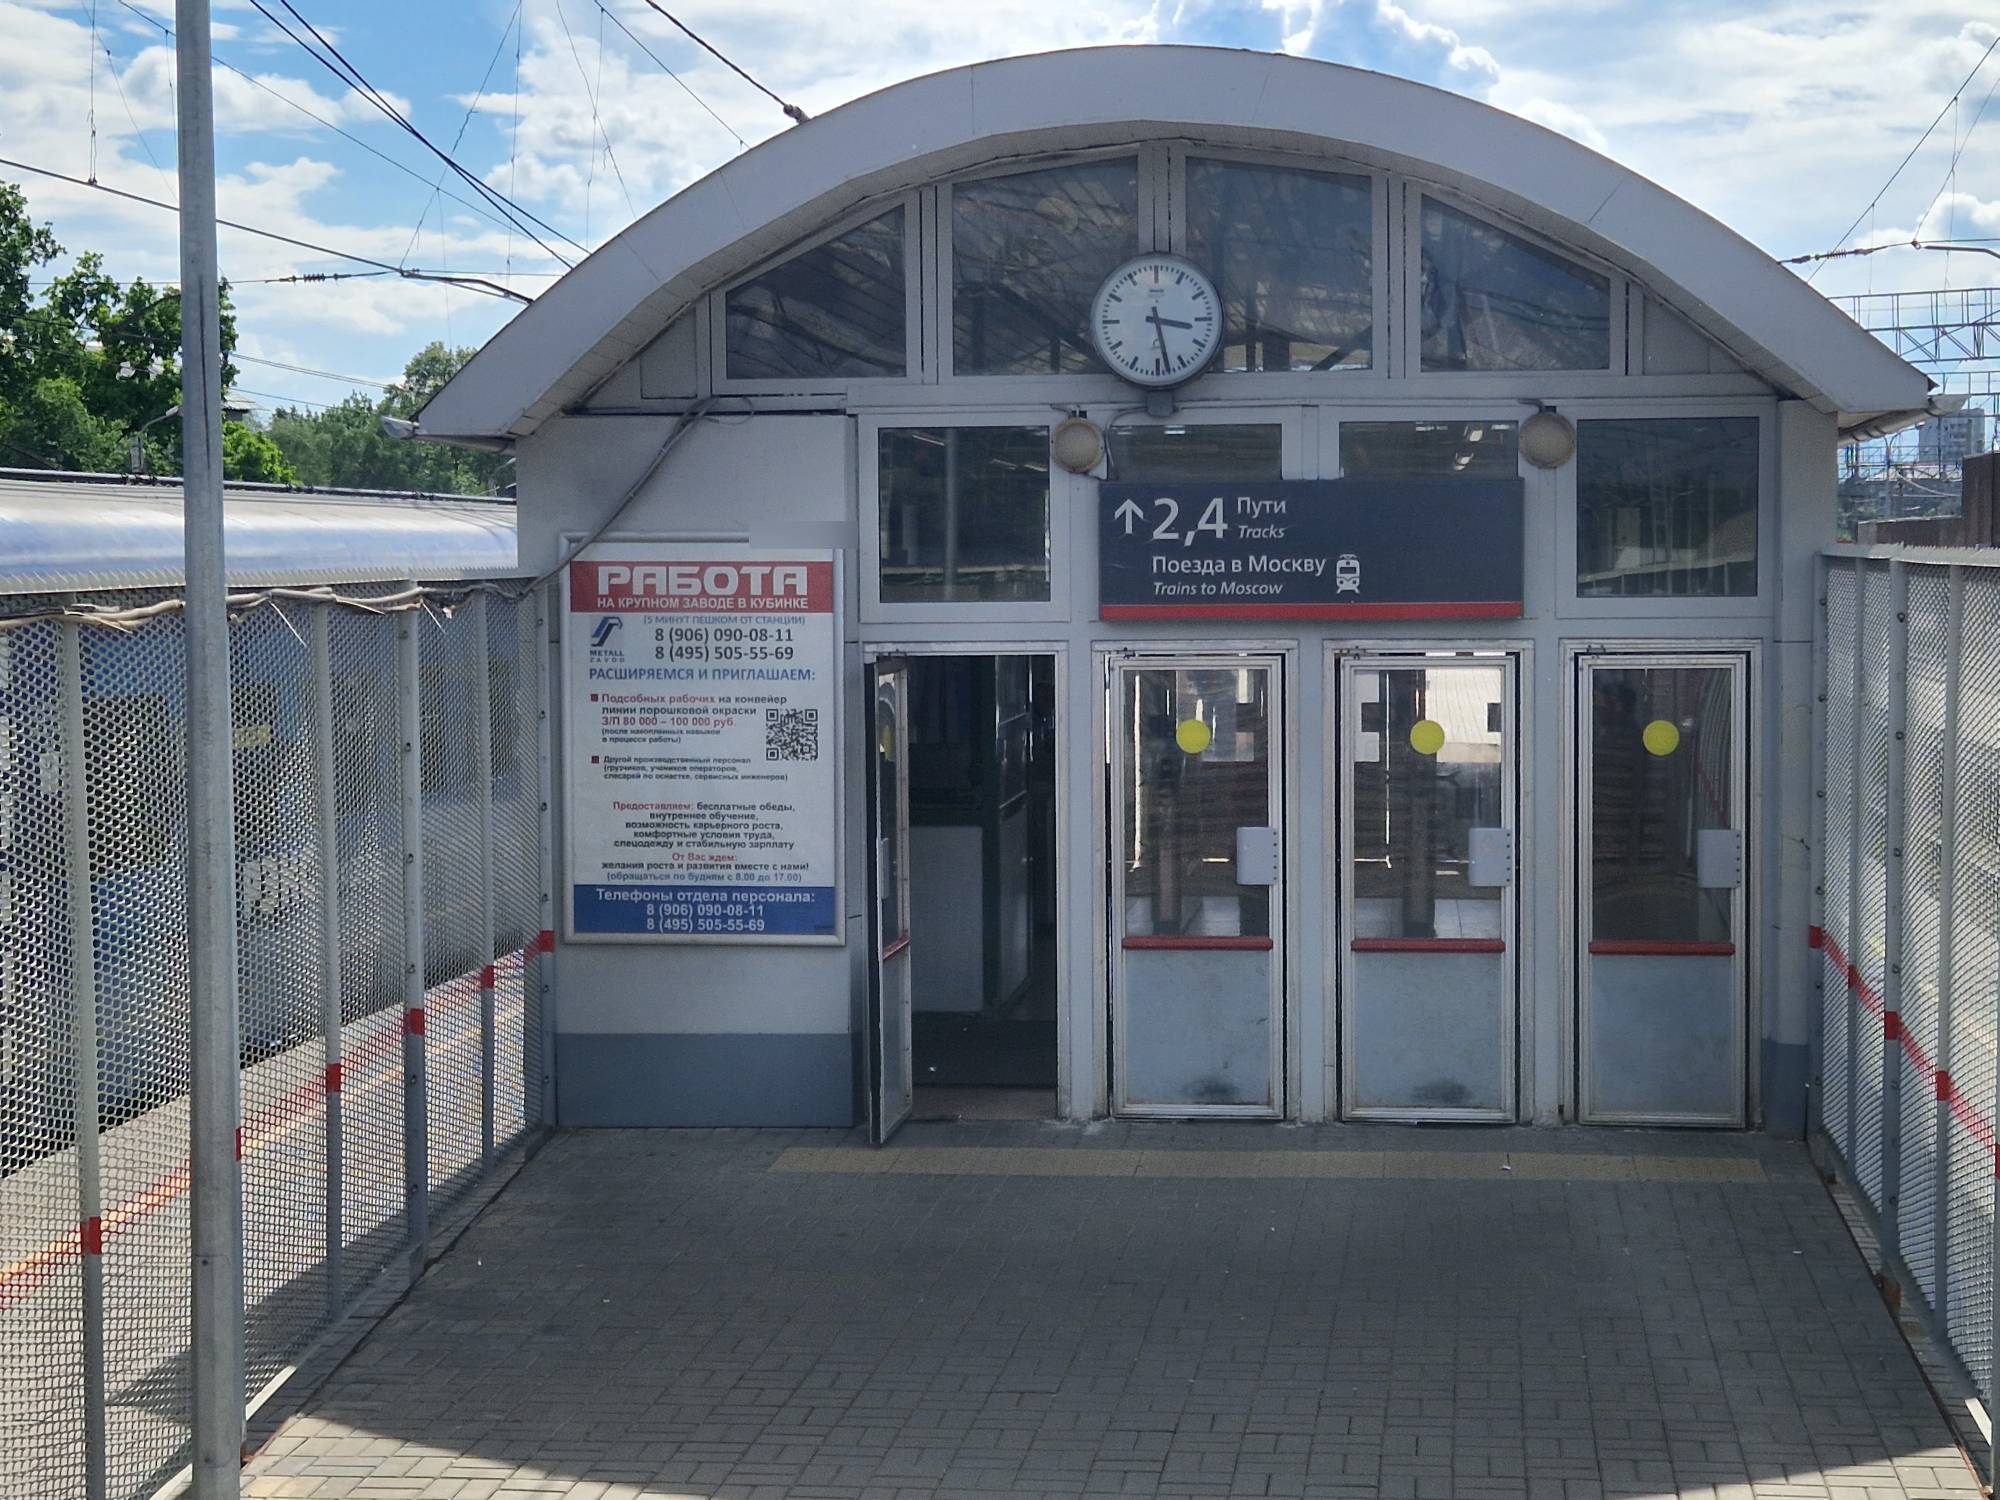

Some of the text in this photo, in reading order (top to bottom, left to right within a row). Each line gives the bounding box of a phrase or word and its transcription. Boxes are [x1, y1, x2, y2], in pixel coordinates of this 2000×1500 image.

[1237, 497, 1286, 517] Пути
[1153, 498, 1228, 546] 2,4
[1238, 525, 1284, 539] Tracks
[1153, 555, 1325, 575] Поезда в Москву
[598, 566, 807, 596] РАБОТА
[1154, 582, 1282, 595] Trains to Moscow
[598, 598, 808, 610] НА КРУПНОМ ЗАВОДЕ В КУБИНКЕ
[656, 616, 690, 624] МИНУТ
[692, 616, 733, 624] ПЕШКОМ
[740, 616, 752, 624] ОТ
[756, 616, 804, 626] СТАНЦИИ)
[655, 628, 792, 644] 8 (906) 090-08-11
[655, 646, 793, 662] 8 (495) 505-55-69
[590, 668, 815, 681] РАСШИРЯЕМСЯ И ПРИГЛАШАЕМ:
[602, 694, 665, 704] Подсобных
[670, 694, 714, 704] рабочих
[735, 695, 786, 704] конвейер
[640, 706, 708, 716] порошковой
[712, 707, 756, 715] окраски
[602, 717, 620, 725] З/П
[624, 717, 635, 725] 80
[639, 717, 657, 725] 000
[671, 717, 688, 725] 100
[692, 717, 710, 725] 000
[697, 802, 756, 811] бесплатные
[759, 803, 795, 812] обеды,
[650, 812, 758, 822] внутреннее обучение,
[694, 822, 749, 830] карьерного
[752, 822, 783, 831] роста,
[634, 830, 774, 840] комфортные условия труда,
[614, 840, 674, 849] спецодежду
[686, 840, 746, 850] стабильную
[750, 842, 794, 850] зарплату
[672, 853, 736, 862] От Вас ждем:
[647, 864, 674, 872] роста
[686, 864, 732, 872] развития
[780, 862, 808, 870] нами!
[607, 872, 670, 882] (обращаться
[673, 874, 685, 882] по
[688, 872, 724, 882] будням
[758, 874, 770, 882] до
[596, 889, 814, 902] Телефоны отдела персонала:
[647, 904, 763, 918] 8 (906) 090-08-11
[647, 918, 764, 932] 8 (495) 505-55-69
